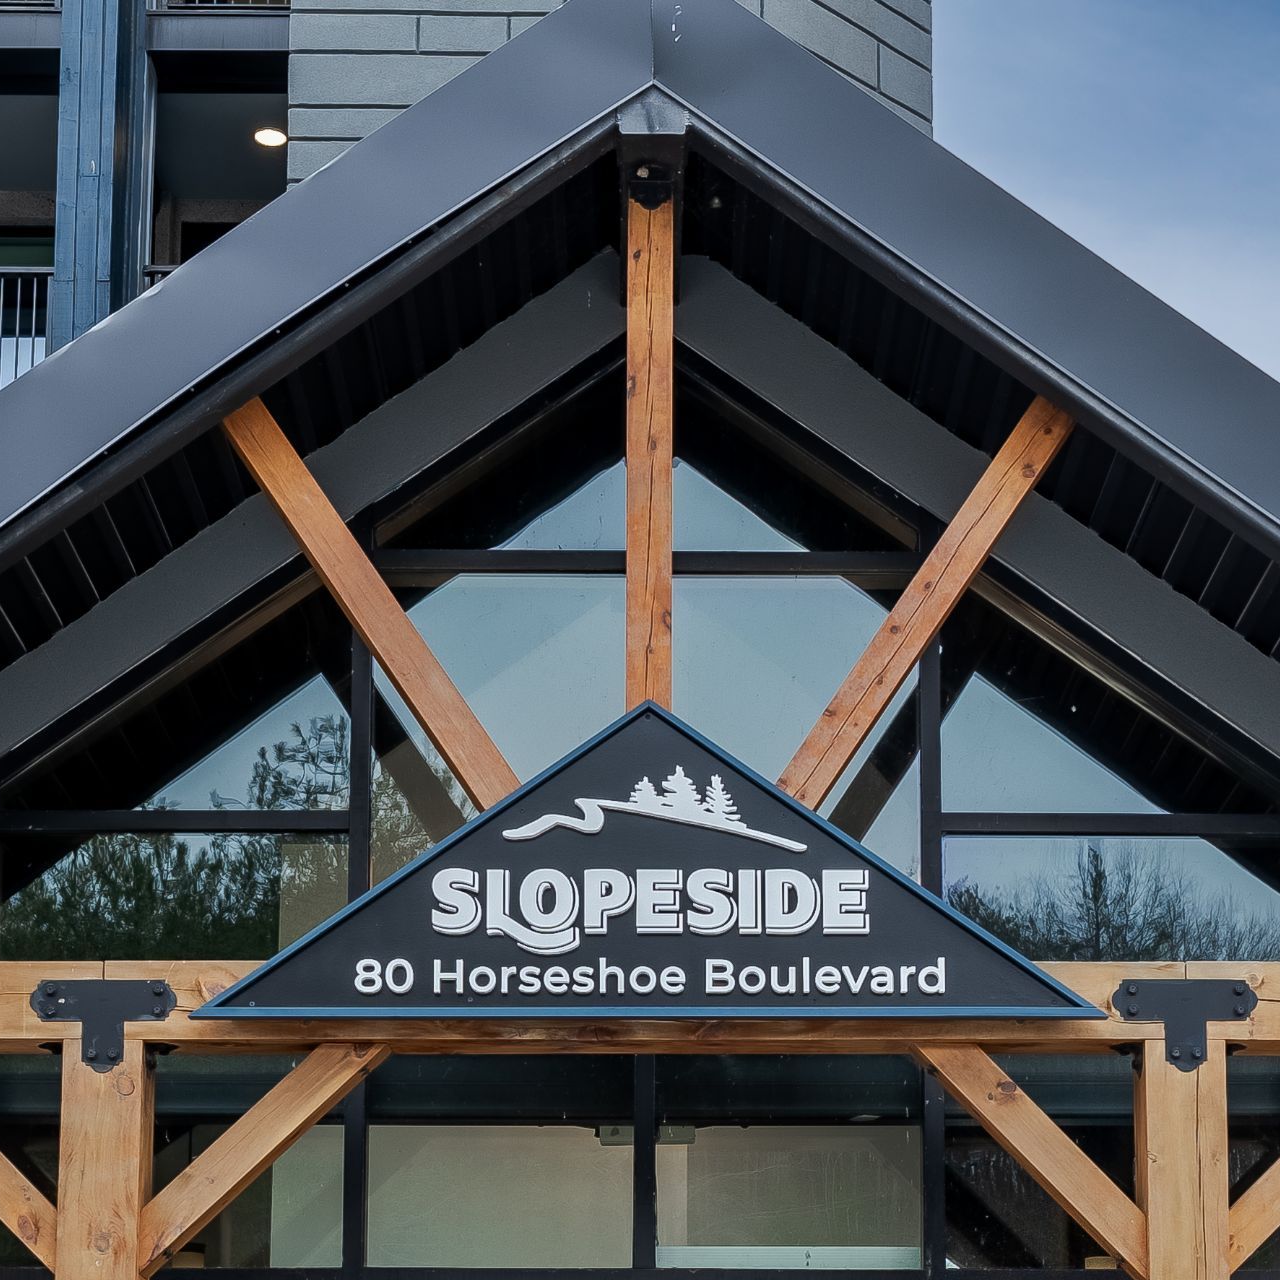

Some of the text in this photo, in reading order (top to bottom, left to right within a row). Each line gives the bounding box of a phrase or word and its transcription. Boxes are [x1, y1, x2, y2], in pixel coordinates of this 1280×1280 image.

[431, 868, 870, 955] SLOPESIDE
[354, 956, 947, 994] 80 Horseshoe Boulevard
